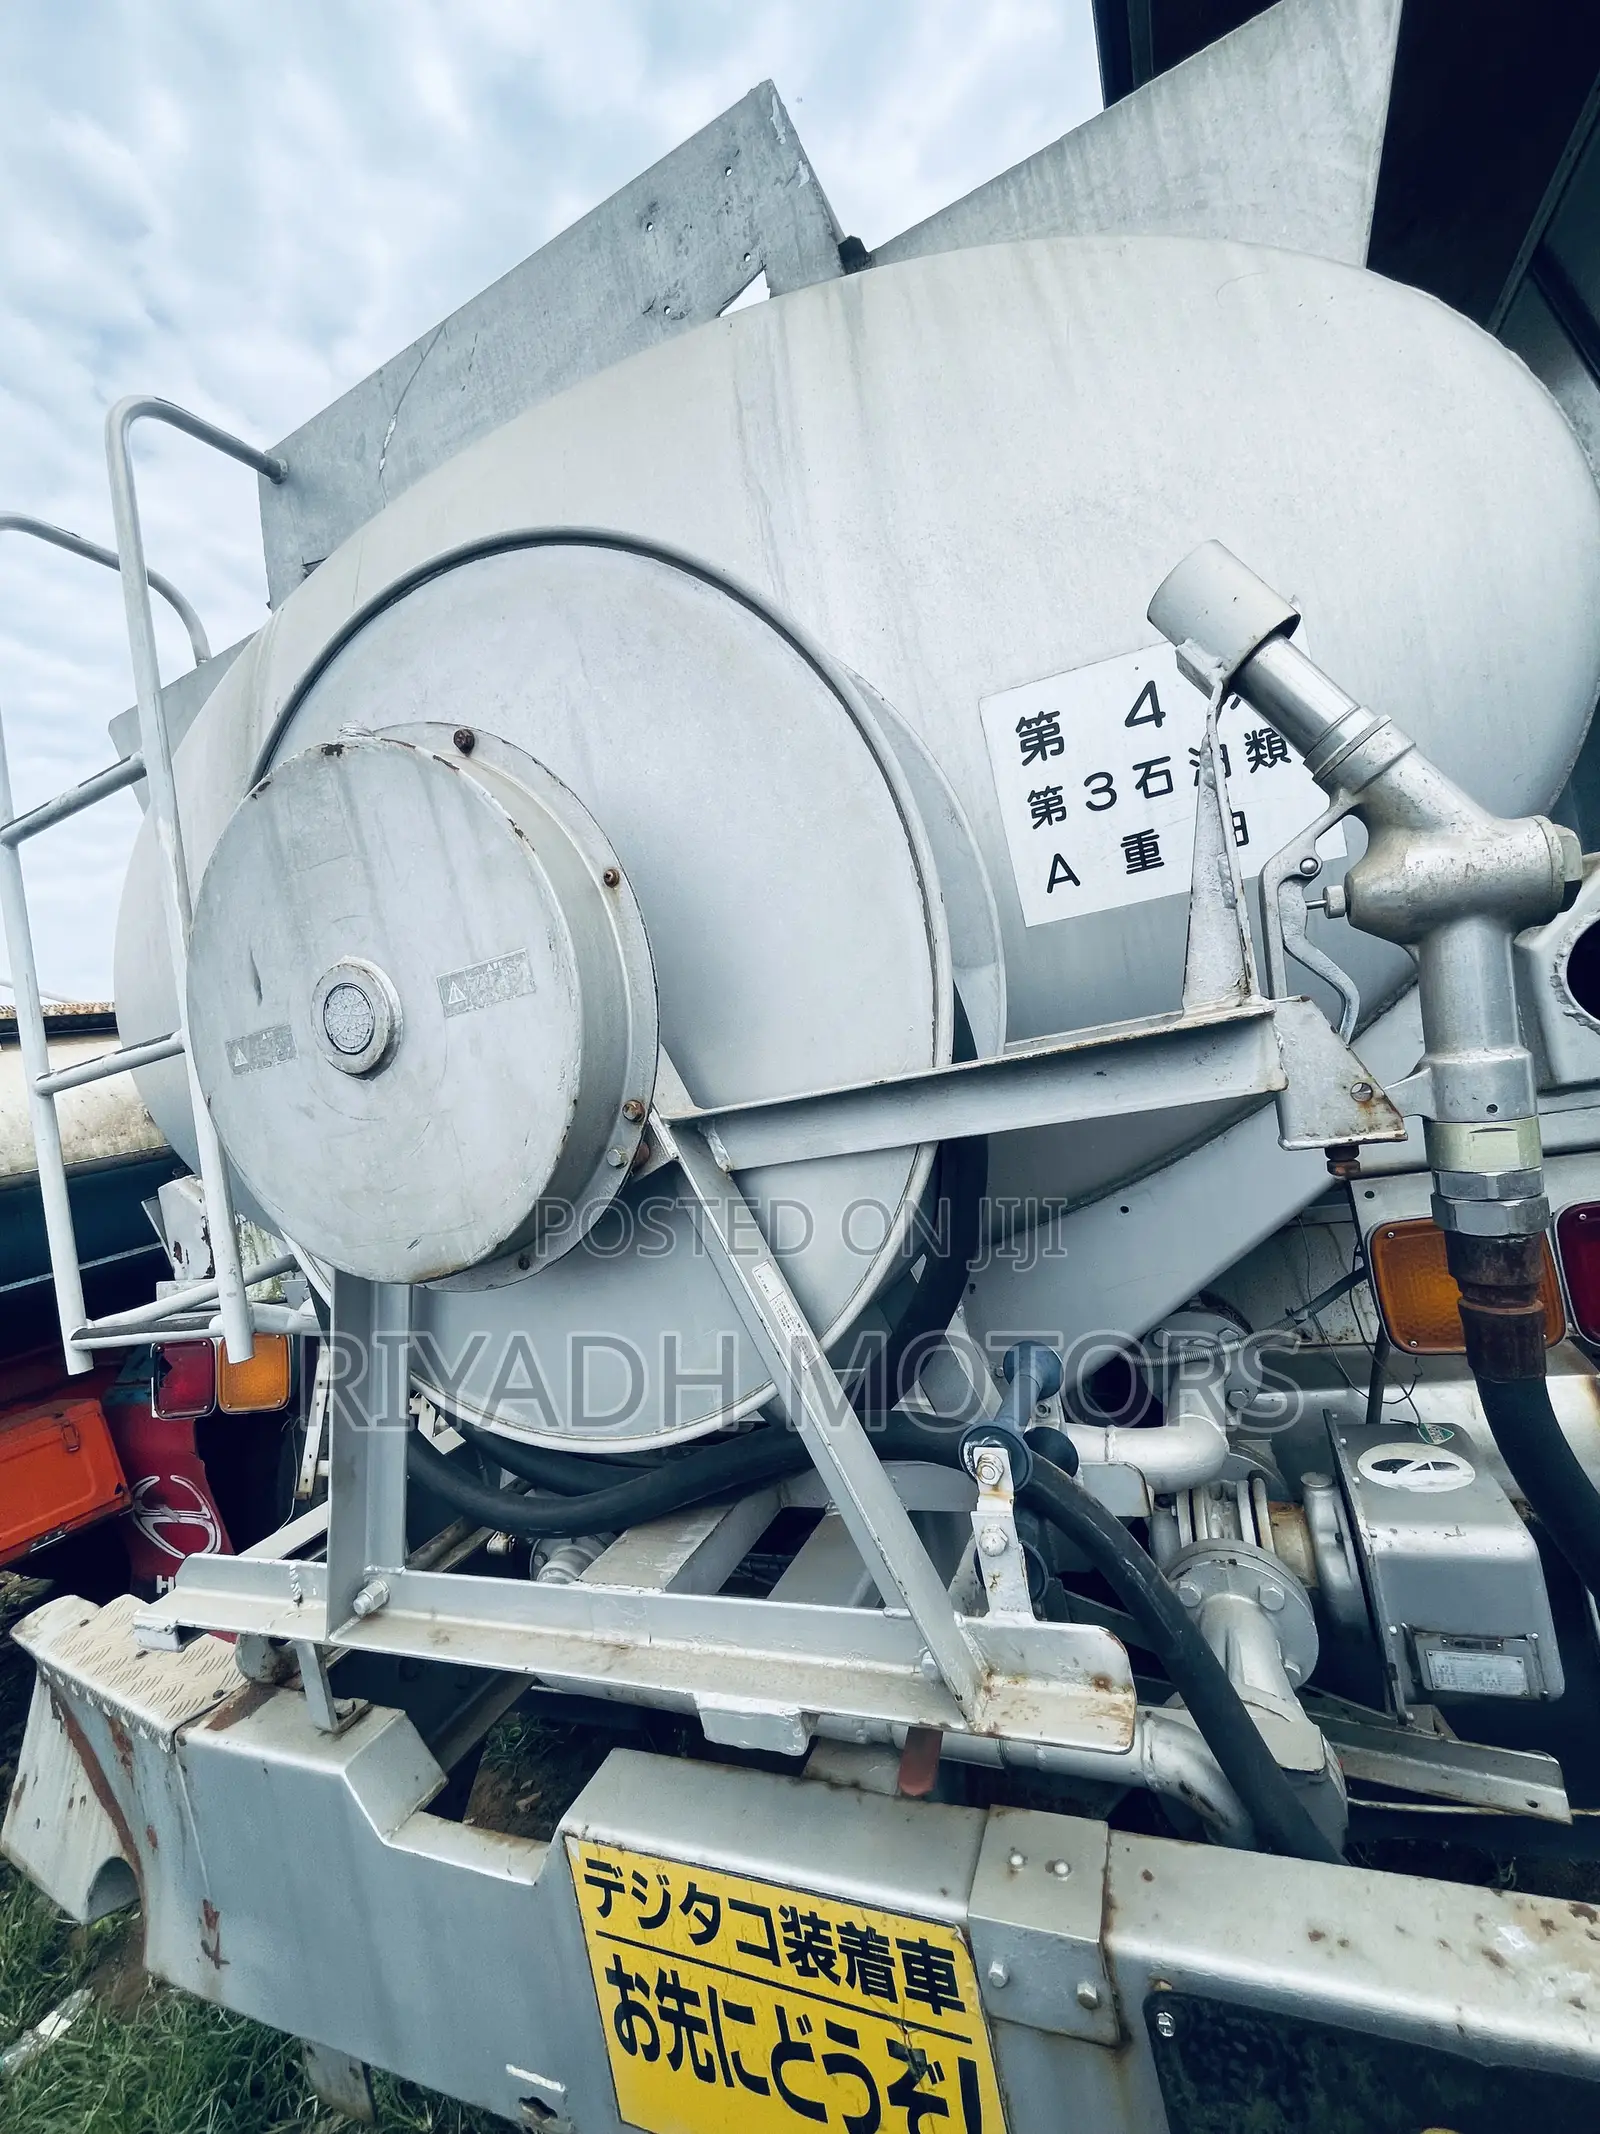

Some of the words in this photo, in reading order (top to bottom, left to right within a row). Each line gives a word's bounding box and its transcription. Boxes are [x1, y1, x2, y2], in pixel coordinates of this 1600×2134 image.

[584, 1857, 966, 2016] デジタコ装着車
